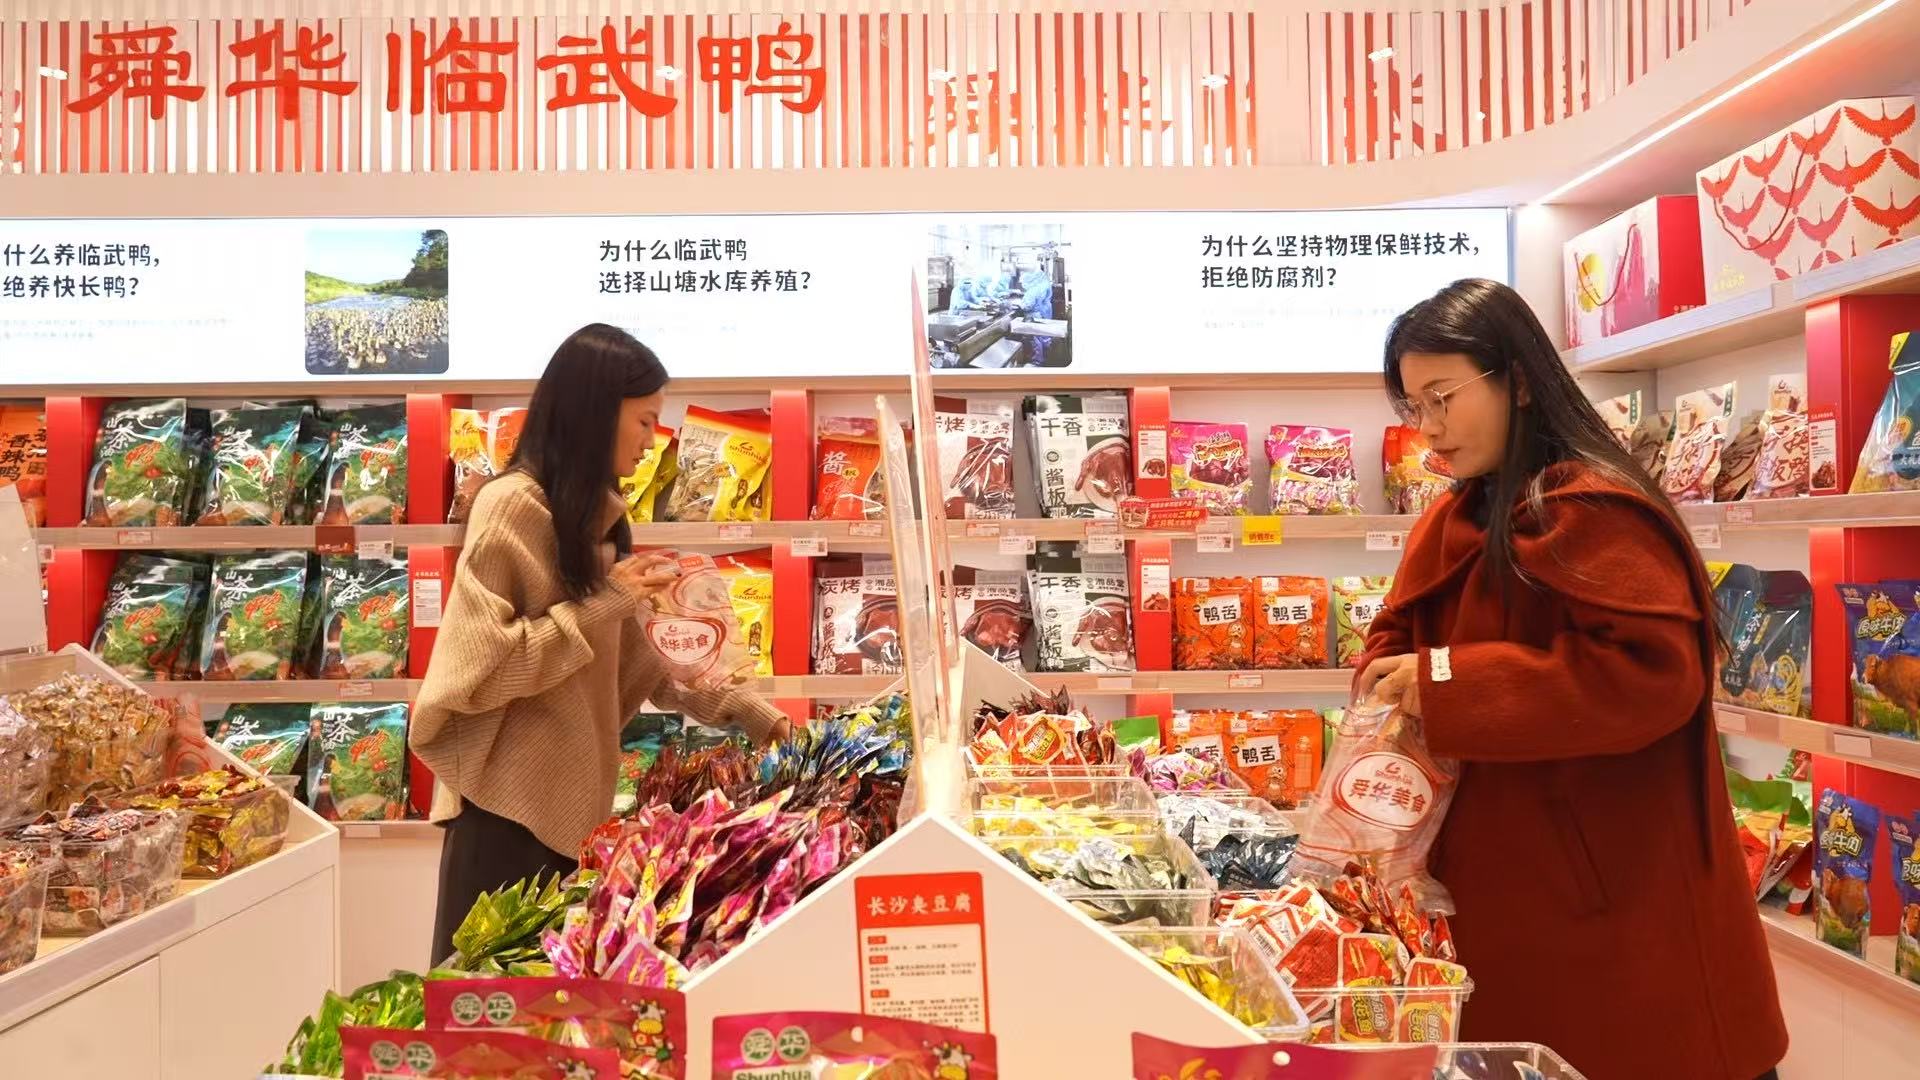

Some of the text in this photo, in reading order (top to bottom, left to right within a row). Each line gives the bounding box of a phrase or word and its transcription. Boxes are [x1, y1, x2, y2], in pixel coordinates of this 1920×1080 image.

[66, 24, 826, 120] 舜华临武鸭
[3, 243, 160, 267] 什么养临武鸭，
[599, 238, 747, 262] 为什么临武鸭
[1202, 232, 1480, 257] 为什么坚持物理保鲜技术，
[3, 275, 139, 298] 绝养快长鸭？
[599, 269, 811, 294] 选择山塘水库养殖？
[1201, 265, 1337, 289] 拒绝防腐剂？
[1041, 416, 1083, 437] 干香
[819, 450, 851, 475] 酱
[819, 578, 862, 596] 炭烤
[1203, 604, 1239, 622] 鸭舌
[1272, 604, 1309, 622] 鸭舌
[1242, 746, 1276, 763] 鸭舌
[1348, 778, 1427, 815] 舜华美食
[867, 892, 972, 918] 长沙臭豆腐
